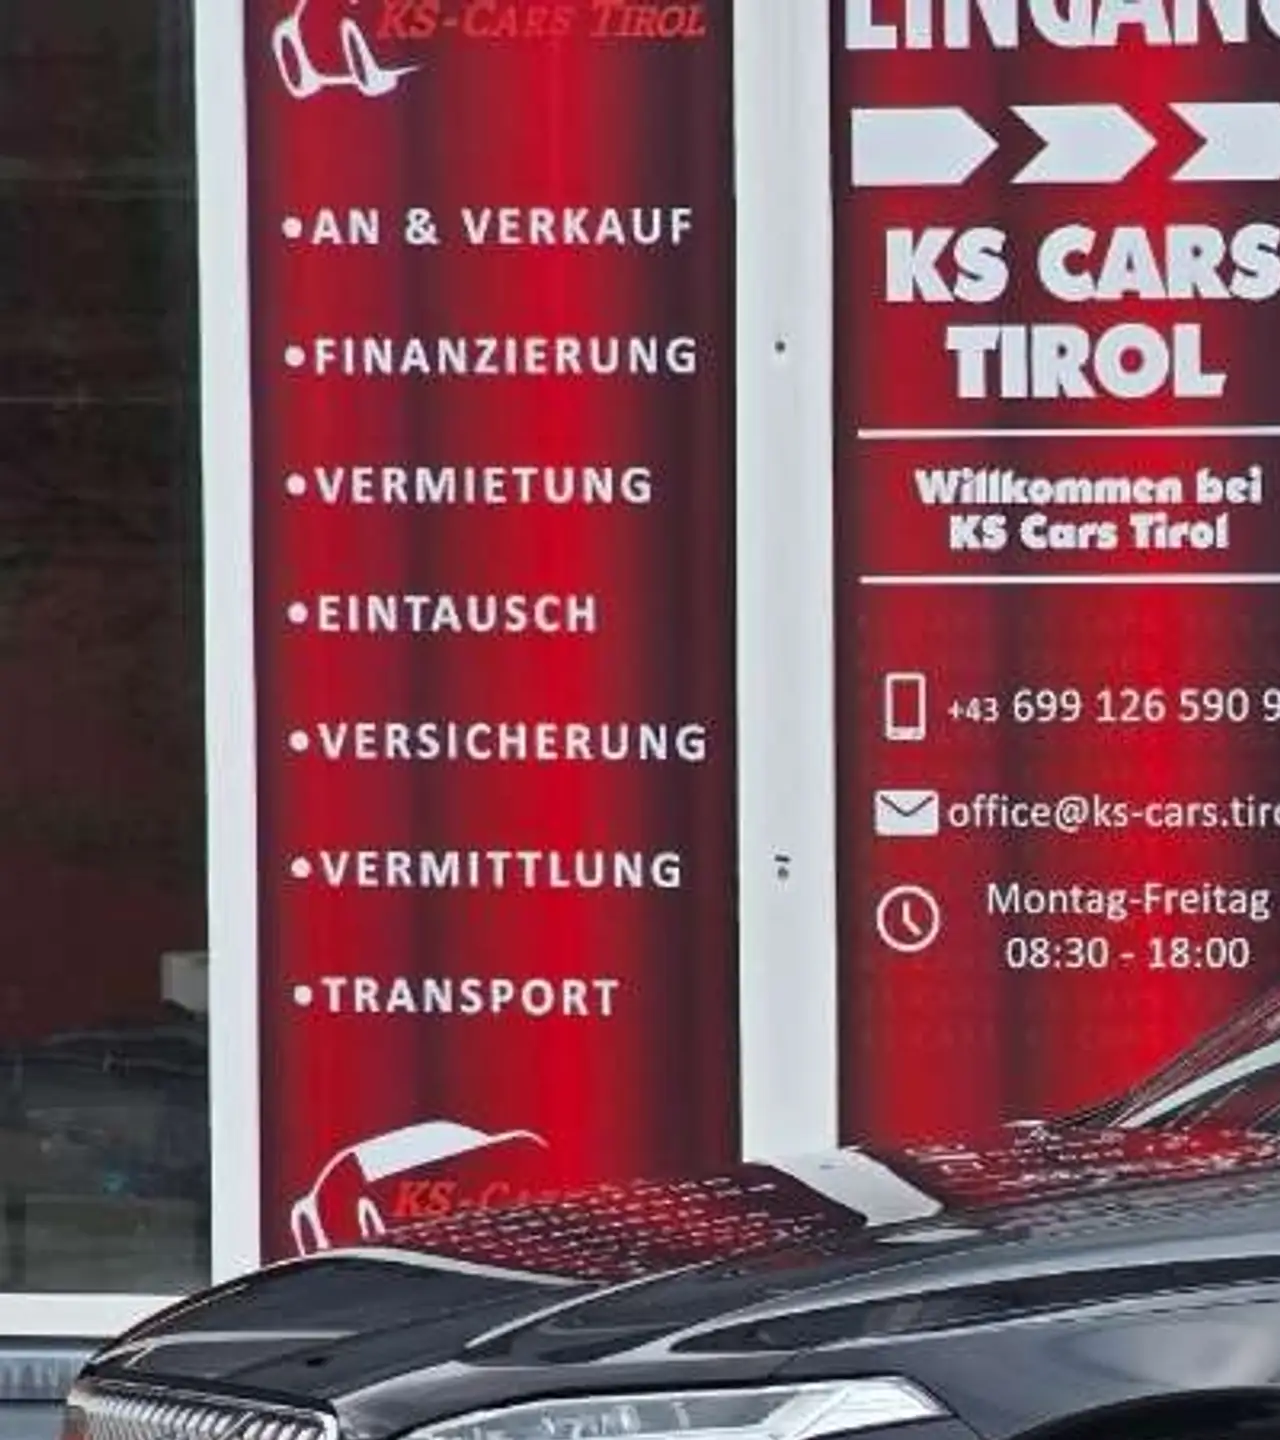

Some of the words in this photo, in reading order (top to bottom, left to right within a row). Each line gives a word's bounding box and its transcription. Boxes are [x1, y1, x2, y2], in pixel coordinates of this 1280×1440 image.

[312, 209, 378, 244] AN
[406, 208, 438, 244] &
[462, 208, 691, 244] VERKAUF
[886, 227, 1008, 302] KS
[315, 337, 695, 374] FINANZIERUNG
[945, 323, 1227, 398] TIROL
[316, 467, 650, 503] VERMIETUNG
[915, 468, 1182, 505] Willkommen
[1197, 466, 1261, 503] bei
[950, 514, 1007, 550] KS
[1020, 513, 1118, 549] Cars
[1130, 512, 1229, 548] Tirol
[319, 595, 594, 631] EINTAUSCH
[949, 698, 999, 721] +43
[1014, 689, 1081, 722] 699
[1098, 689, 1165, 721] 126
[1181, 688, 1249, 721] 590
[318, 723, 705, 761] VERSICHERUNG
[320, 851, 680, 887] VERMITTLUNG
[988, 883, 1269, 921] Montag-Freitag
[1006, 938, 1108, 968] 08:30
[1150, 938, 1249, 968] 18:00
[322, 977, 618, 1015] TRANSPORT
